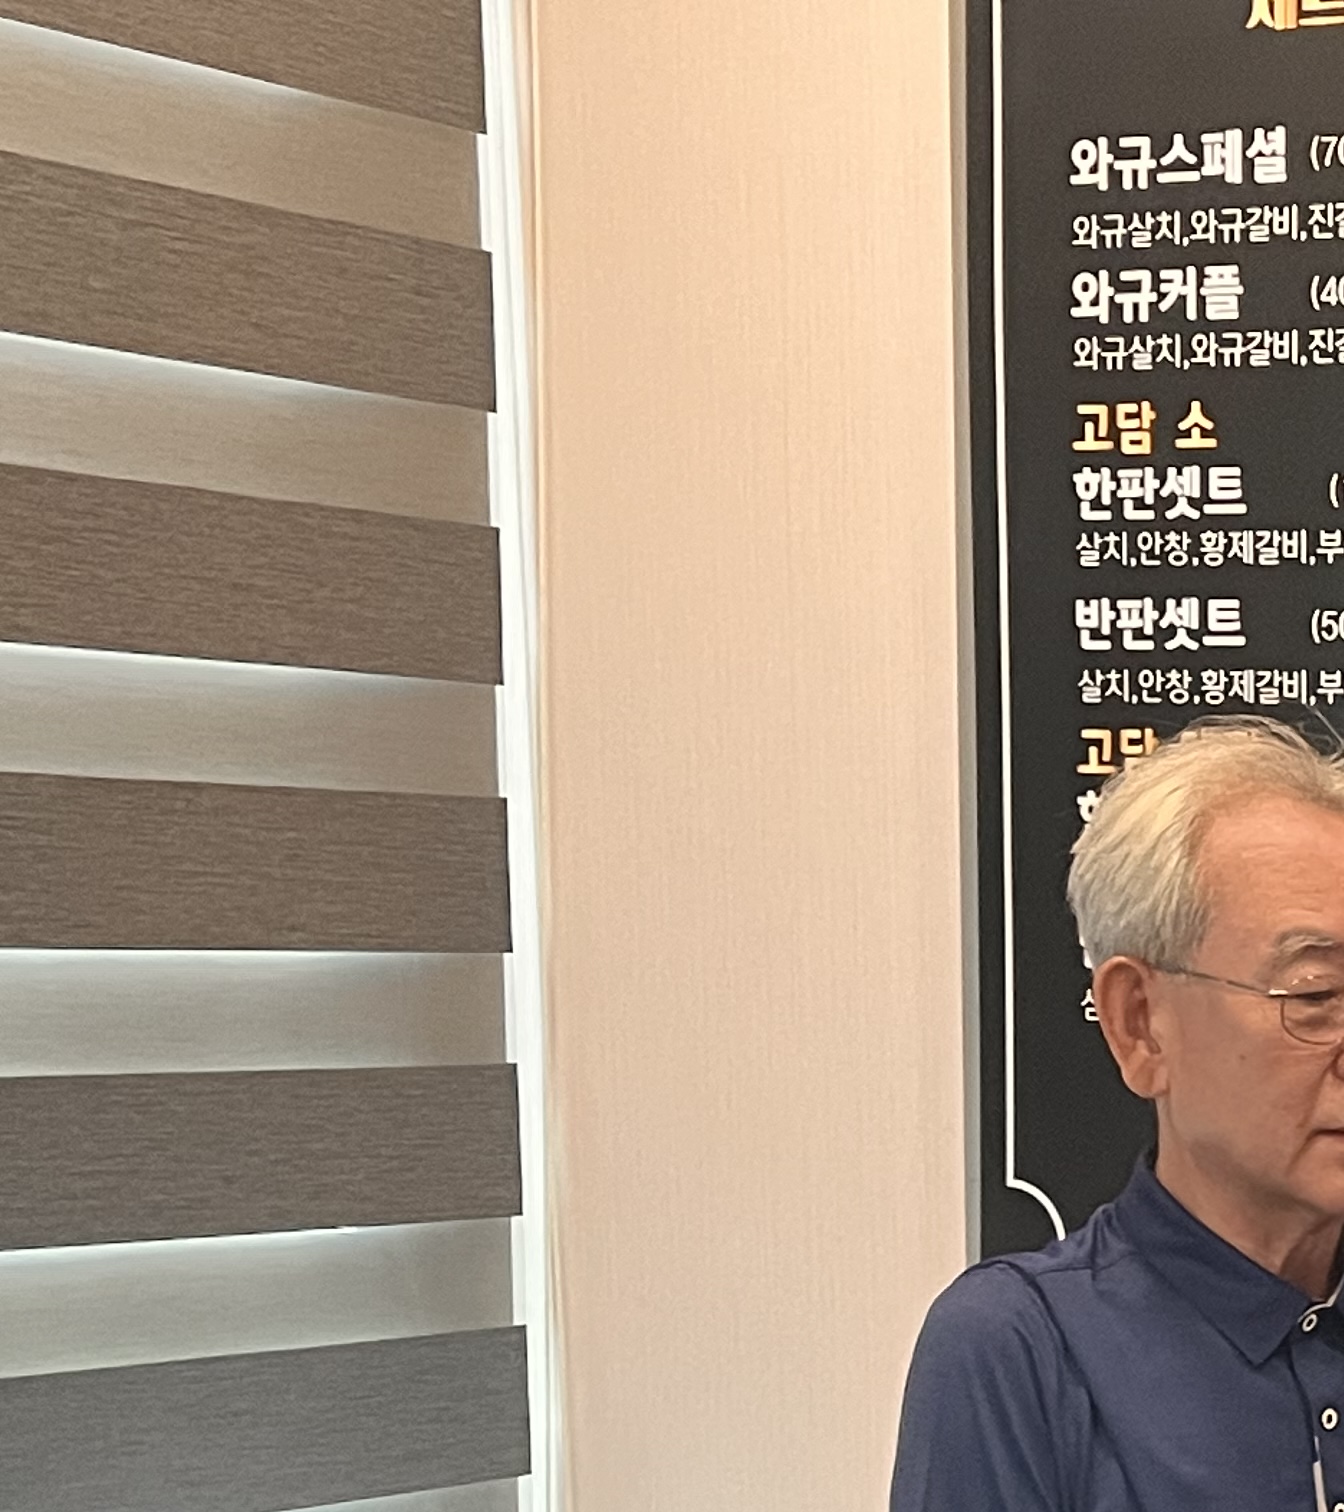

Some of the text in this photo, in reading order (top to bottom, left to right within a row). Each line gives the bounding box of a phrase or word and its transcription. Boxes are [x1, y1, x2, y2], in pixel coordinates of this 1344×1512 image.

[1069, 125, 1288, 192] 와규스페셜
[1070, 264, 1244, 324] 와규커플
[1072, 400, 1217, 455] 고담 소
[1072, 465, 1248, 521] 한판셋트
[1075, 597, 1247, 651] 반판셋트
